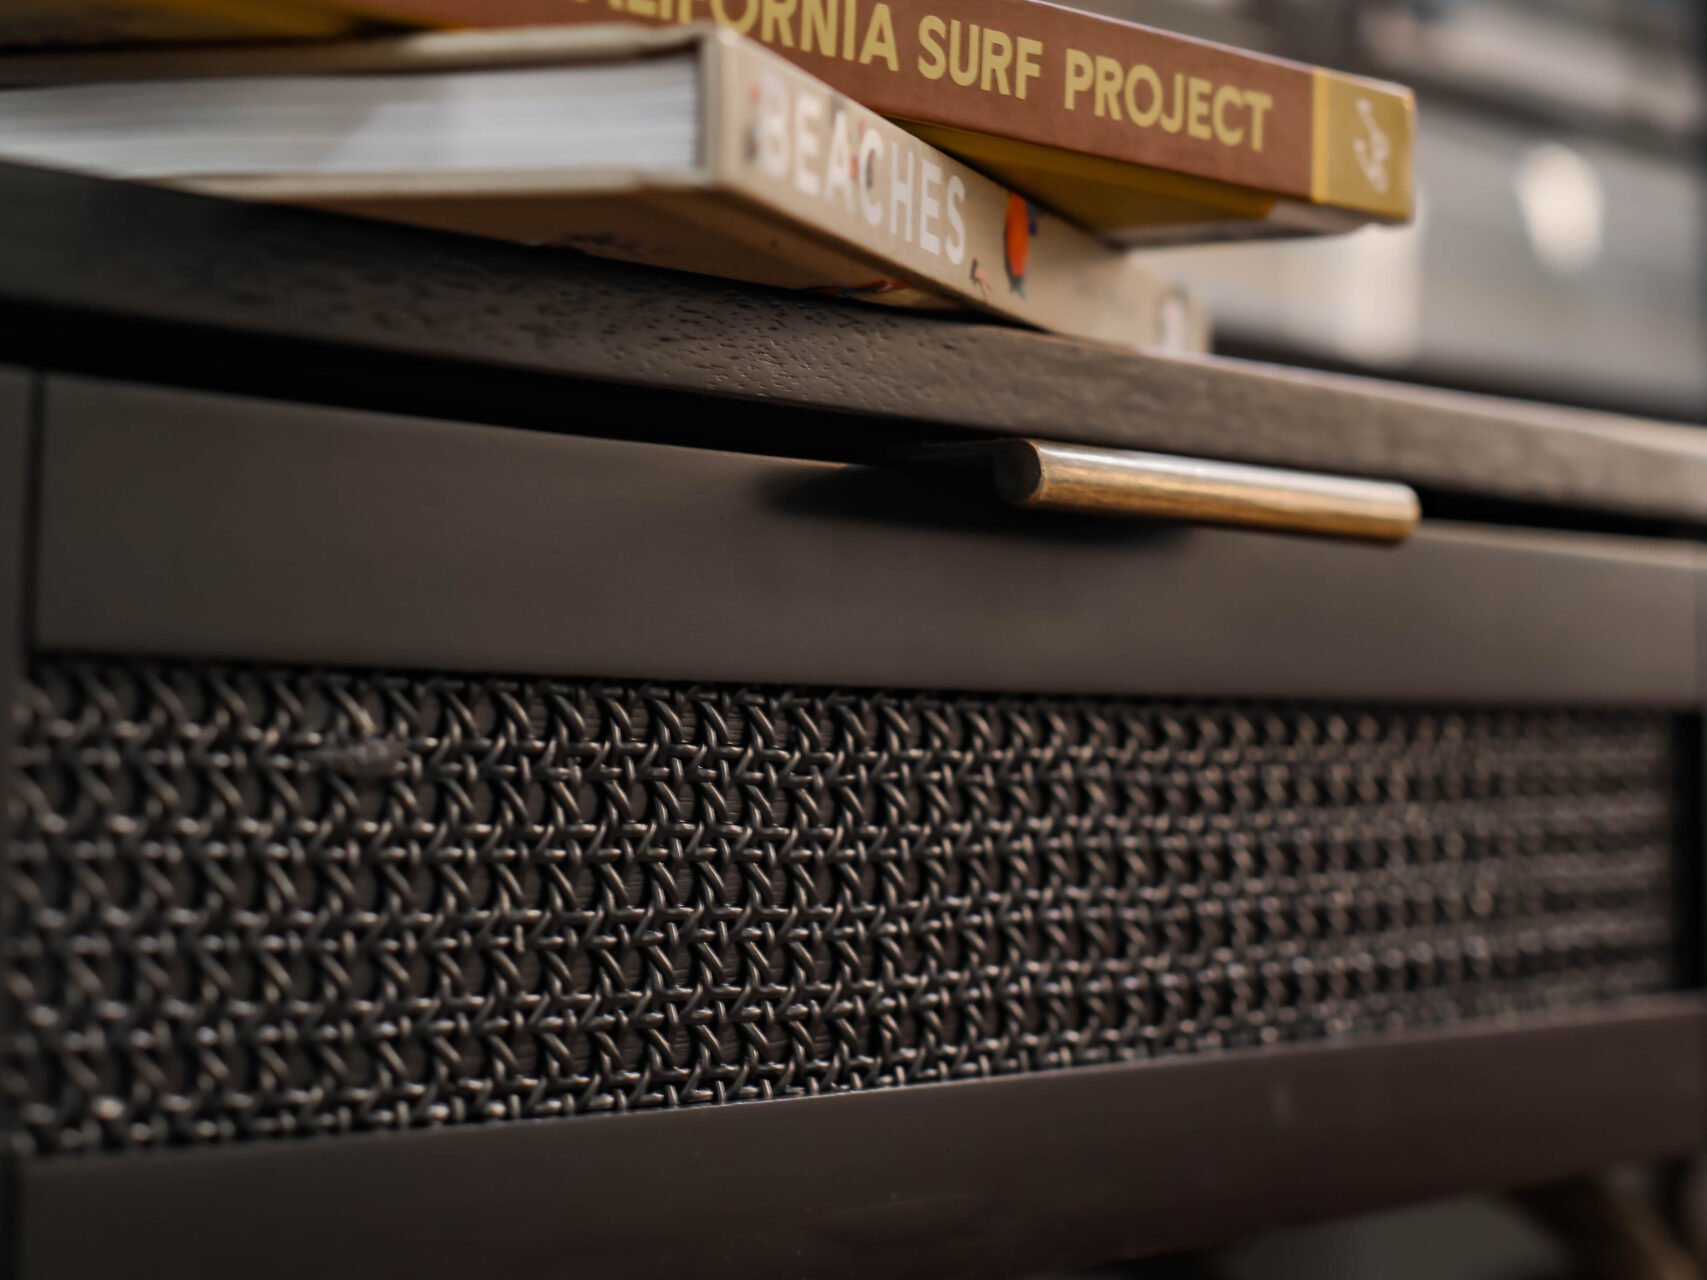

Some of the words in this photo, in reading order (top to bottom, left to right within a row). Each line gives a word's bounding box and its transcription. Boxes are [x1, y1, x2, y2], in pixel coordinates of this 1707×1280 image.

[918, 15, 1043, 100] SURF
[1064, 48, 1273, 152] PROJECT
[757, 70, 967, 266] BEACHES
